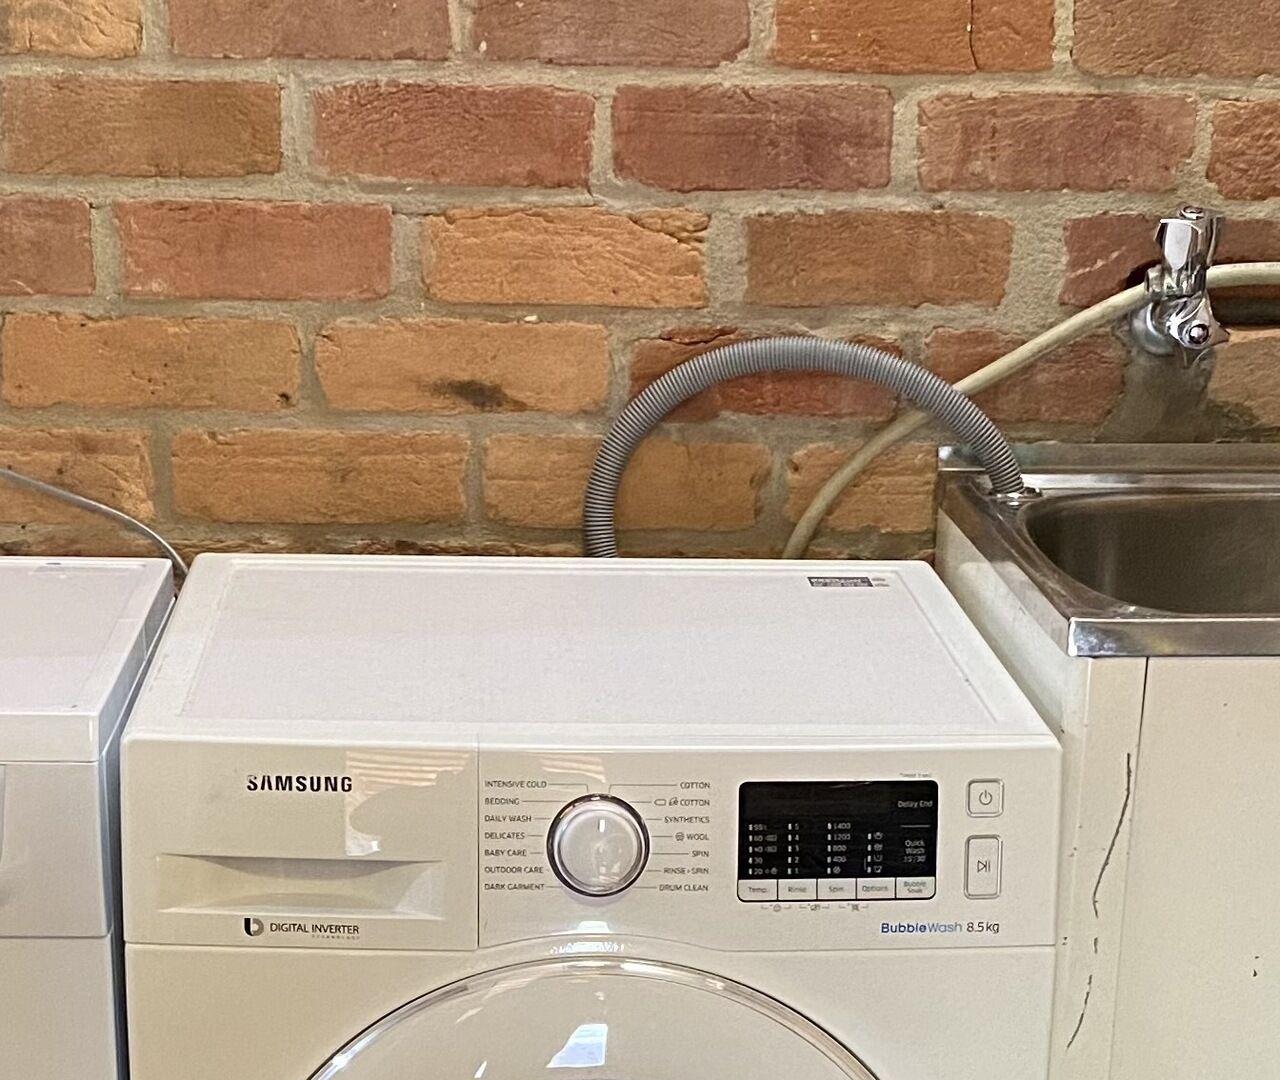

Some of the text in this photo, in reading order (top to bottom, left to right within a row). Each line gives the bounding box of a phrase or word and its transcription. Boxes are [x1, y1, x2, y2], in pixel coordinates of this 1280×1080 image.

[247, 774, 352, 792] SAMSUNG
[484, 780, 547, 788] INTENSIVE COLD
[484, 797, 520, 805] BEDDING
[897, 800, 933, 808] Delay End
[833, 822, 851, 830] 1400
[686, 833, 709, 841] WOOL
[833, 833, 851, 841] 1200
[507, 849, 527, 857] CARE
[524, 866, 544, 874] CARE
[507, 883, 545, 891] GARMENT
[270, 923, 359, 934] DIGITAL INVERTER
[881, 921, 962, 933] BubbleWash
